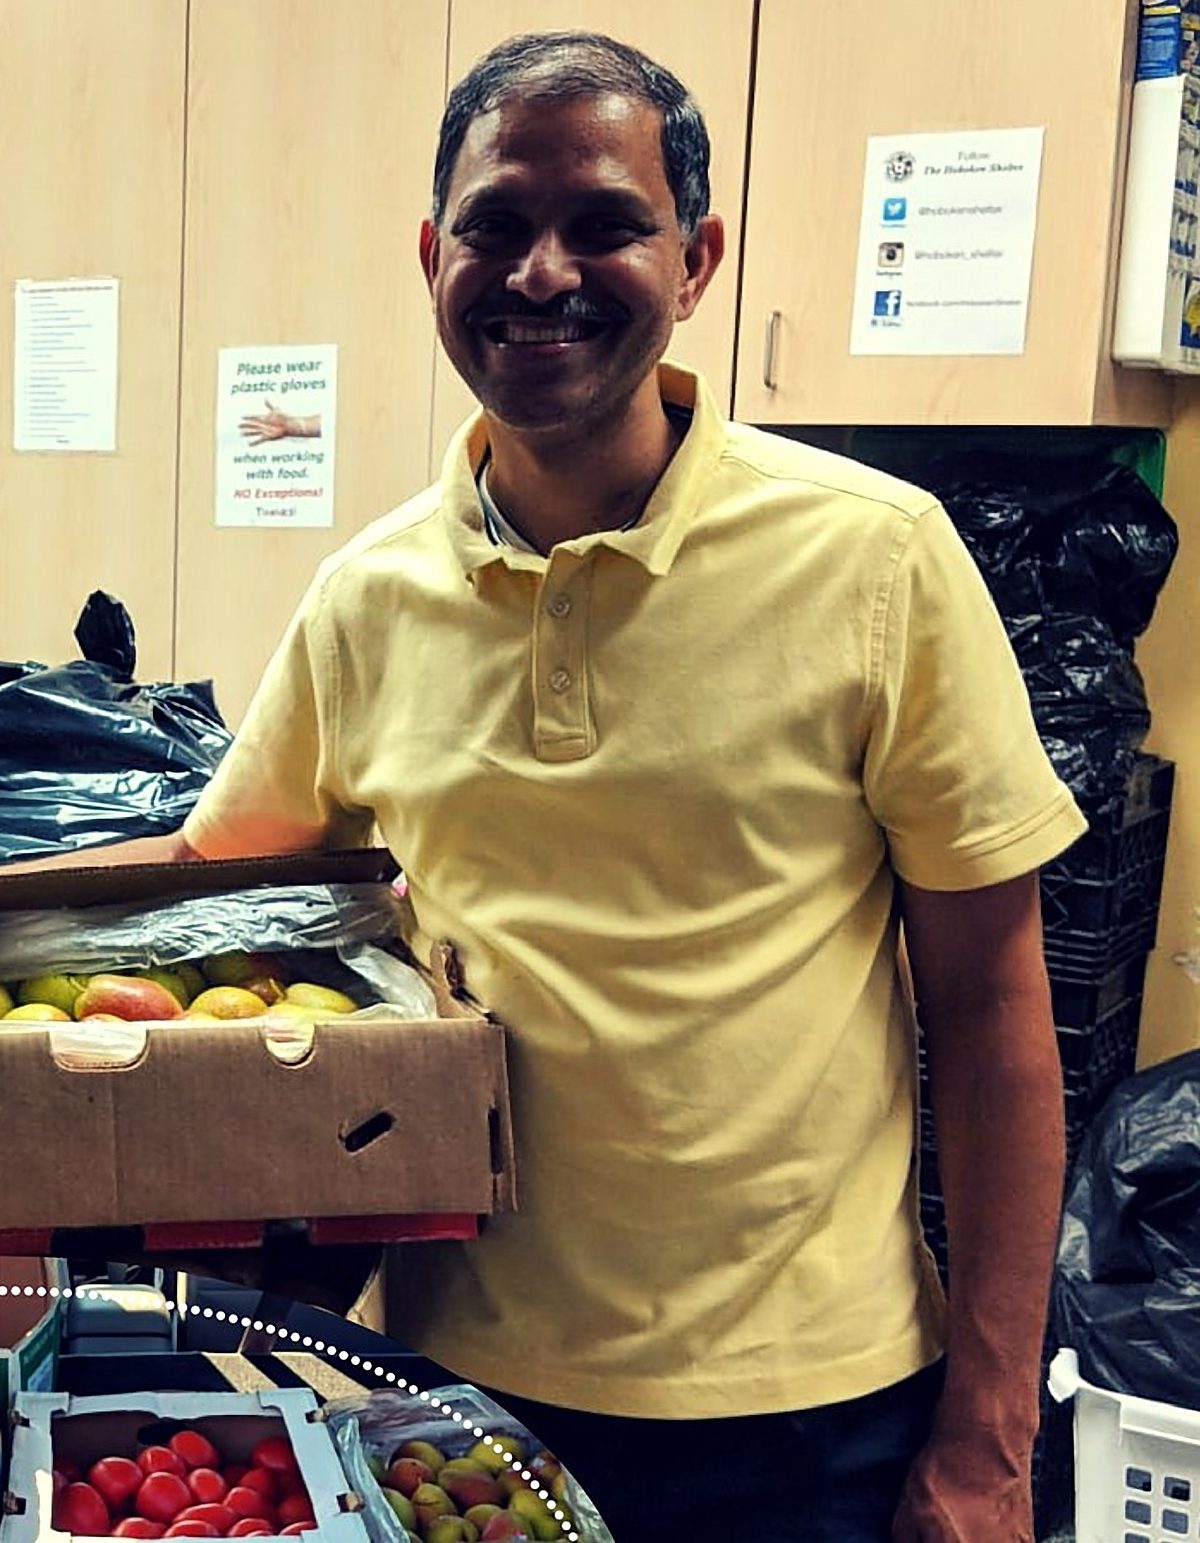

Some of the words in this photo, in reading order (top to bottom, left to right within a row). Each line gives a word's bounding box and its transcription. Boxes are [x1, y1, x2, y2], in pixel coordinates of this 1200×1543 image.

[237, 362, 282, 376] Please
[287, 361, 323, 373] wear
[231, 380, 277, 395] plastic
[281, 378, 326, 394] gloves
[234, 453, 267, 464] when
[272, 451, 324, 464] working
[247, 467, 273, 480] with
[278, 467, 309, 479] food.
[255, 487, 324, 500] Exceptions!
